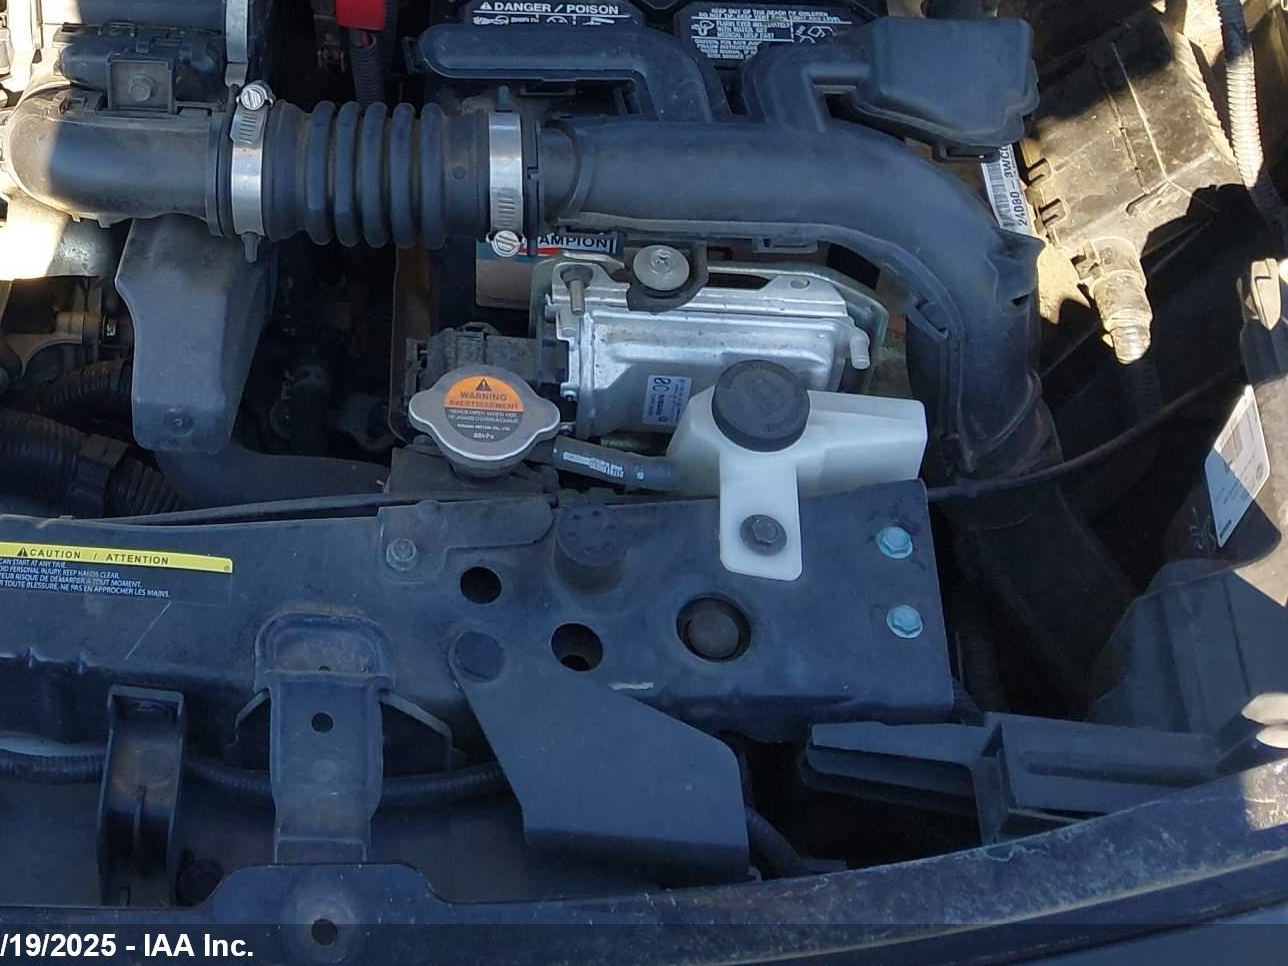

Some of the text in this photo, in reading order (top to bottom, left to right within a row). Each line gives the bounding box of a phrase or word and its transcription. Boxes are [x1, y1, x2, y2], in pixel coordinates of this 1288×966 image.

[494, 2, 618, 15] DANGER / POISON
[1009, 191, 1029, 227] 24080
[539, 235, 608, 248] AMPION
[460, 391, 508, 402] WARNING
[448, 400, 519, 410] AVERTISSEMENT
[13, 558, 31, 566] START
[31, 559, 39, 567] AT
[39, 560, 52, 568] ANY
[30, 548, 81, 559] CAUTION
[106, 553, 169, 565] ATTENTION
[9, 565, 40, 574] PERSONAL
[62, 568, 78, 576] KEEP
[78, 569, 99, 577] HANDS
[16, 573, 38, 581] RISQUE
[39, 574, 49, 582] DE
[93, 578, 111, 586] TOUT
[5, 580, 26, 588] TOUTE
[61, 583, 70, 591] NE
[71, 584, 83, 592] PAS
[93, 585, 133, 594] APPROCHER
[134, 588, 146, 596] LES
